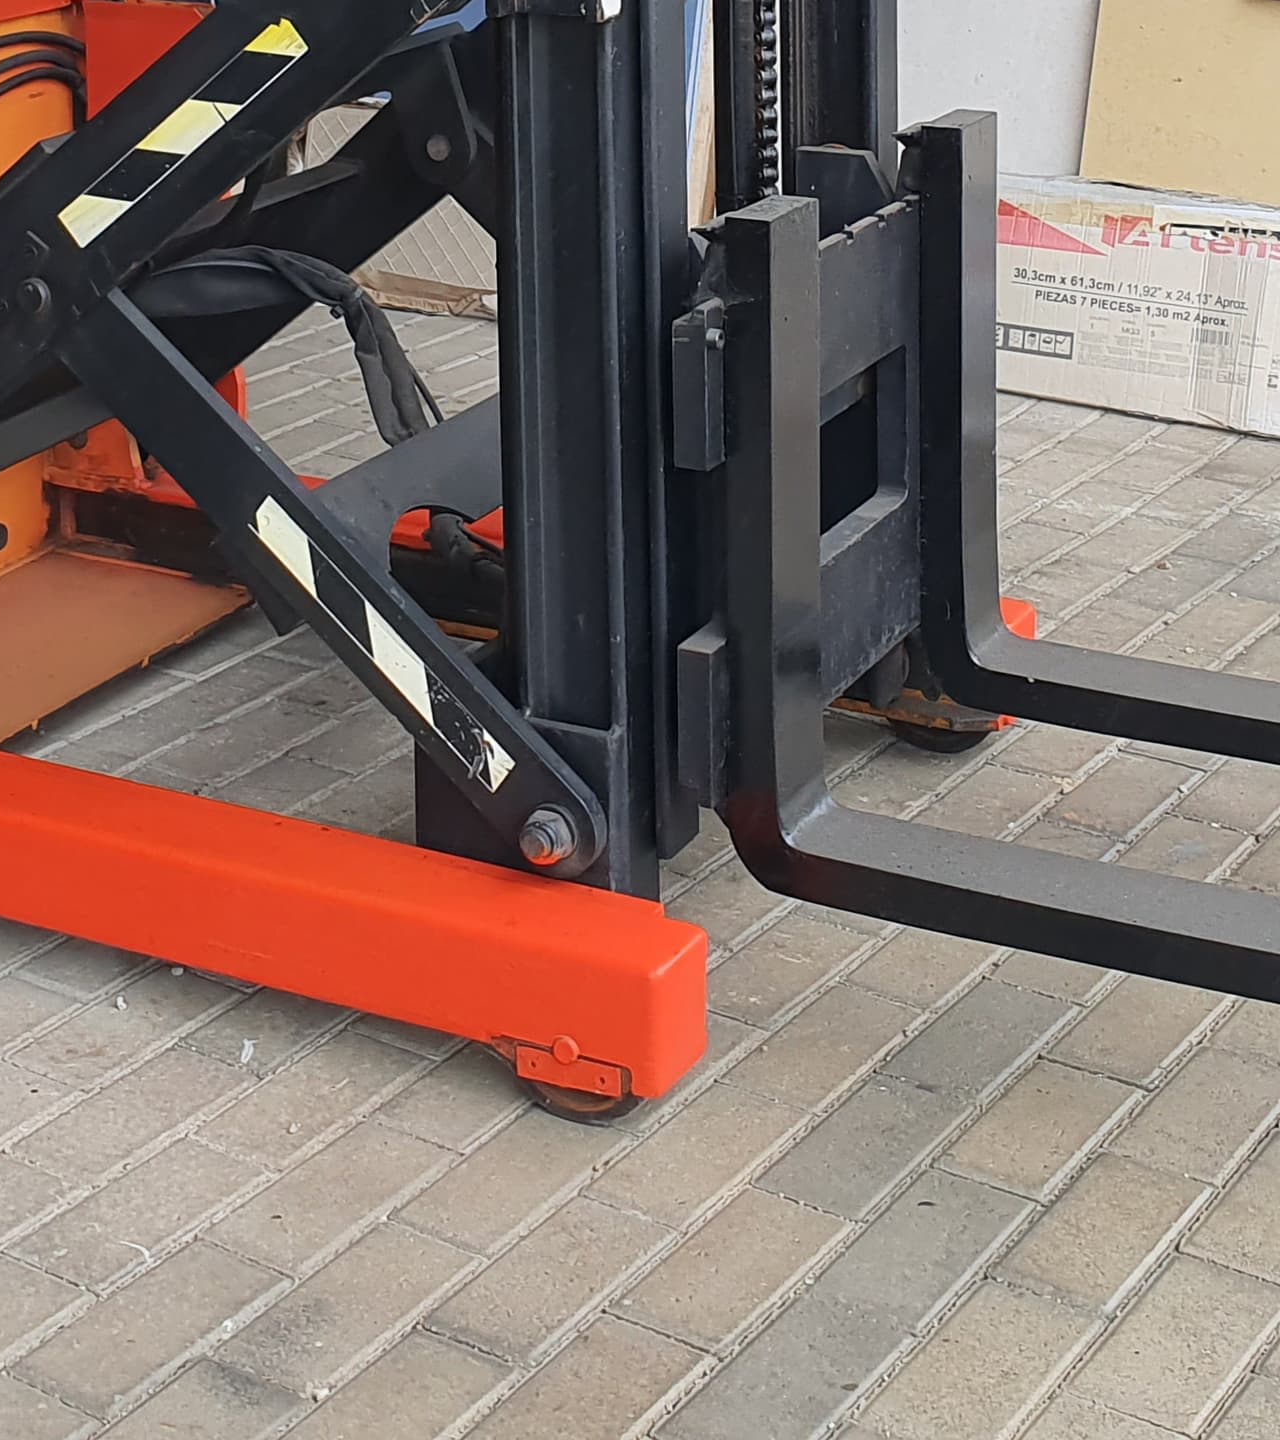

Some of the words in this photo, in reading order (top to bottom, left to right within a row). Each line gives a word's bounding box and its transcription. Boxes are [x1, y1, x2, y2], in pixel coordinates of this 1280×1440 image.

[1013, 267, 1056, 283] 30,3cm
[1060, 275, 1067, 286] x
[1070, 275, 1115, 291] 61,3cm
[1165, 292, 1173, 300] x
[1035, 289, 1077, 305] PIEZAS
[1081, 296, 1087, 306] 7
[1145, 305, 1169, 318] 1,30
[1172, 311, 1191, 321] m2
[1193, 313, 1229, 327] Aprox.
